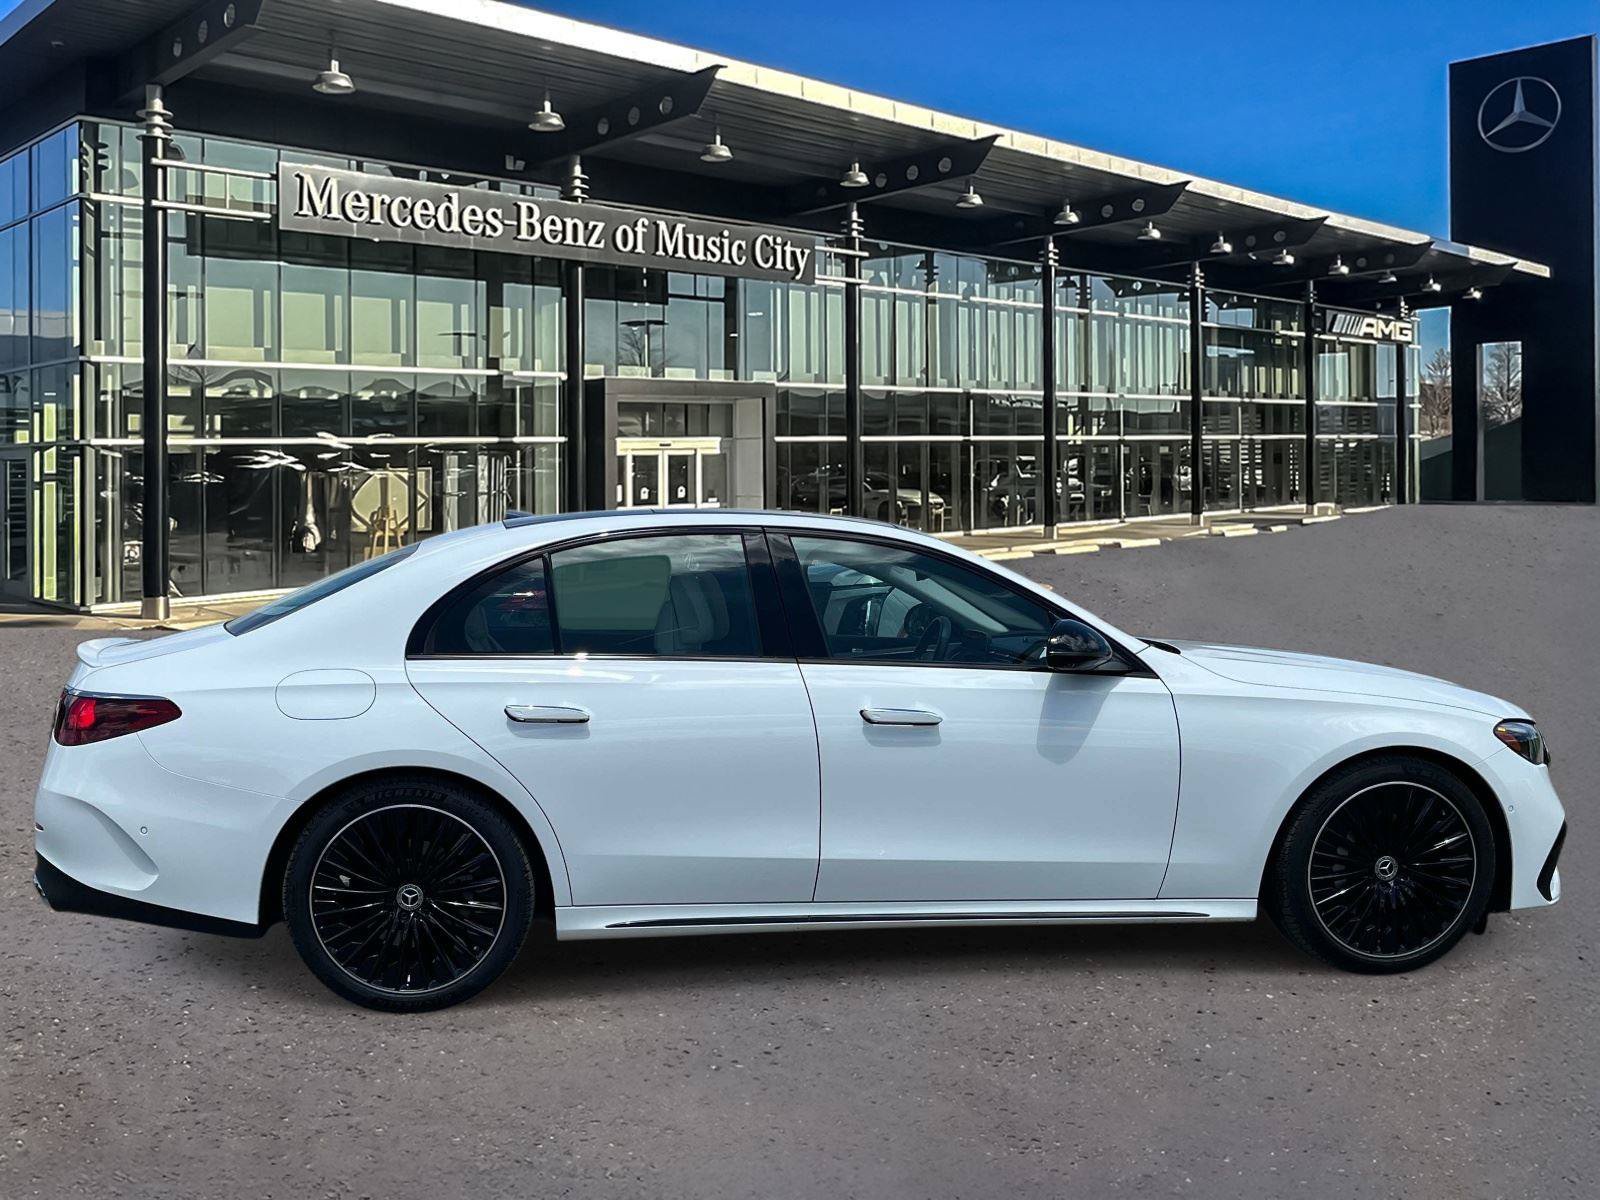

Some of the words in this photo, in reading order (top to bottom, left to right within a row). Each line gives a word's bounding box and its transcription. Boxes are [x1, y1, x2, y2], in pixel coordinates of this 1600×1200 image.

[294, 171, 606, 249] Mercedes-Benz
[613, 217, 649, 254] of
[654, 219, 747, 266] Music
[753, 233, 811, 281] City
[1358, 317, 1412, 342] AMG
